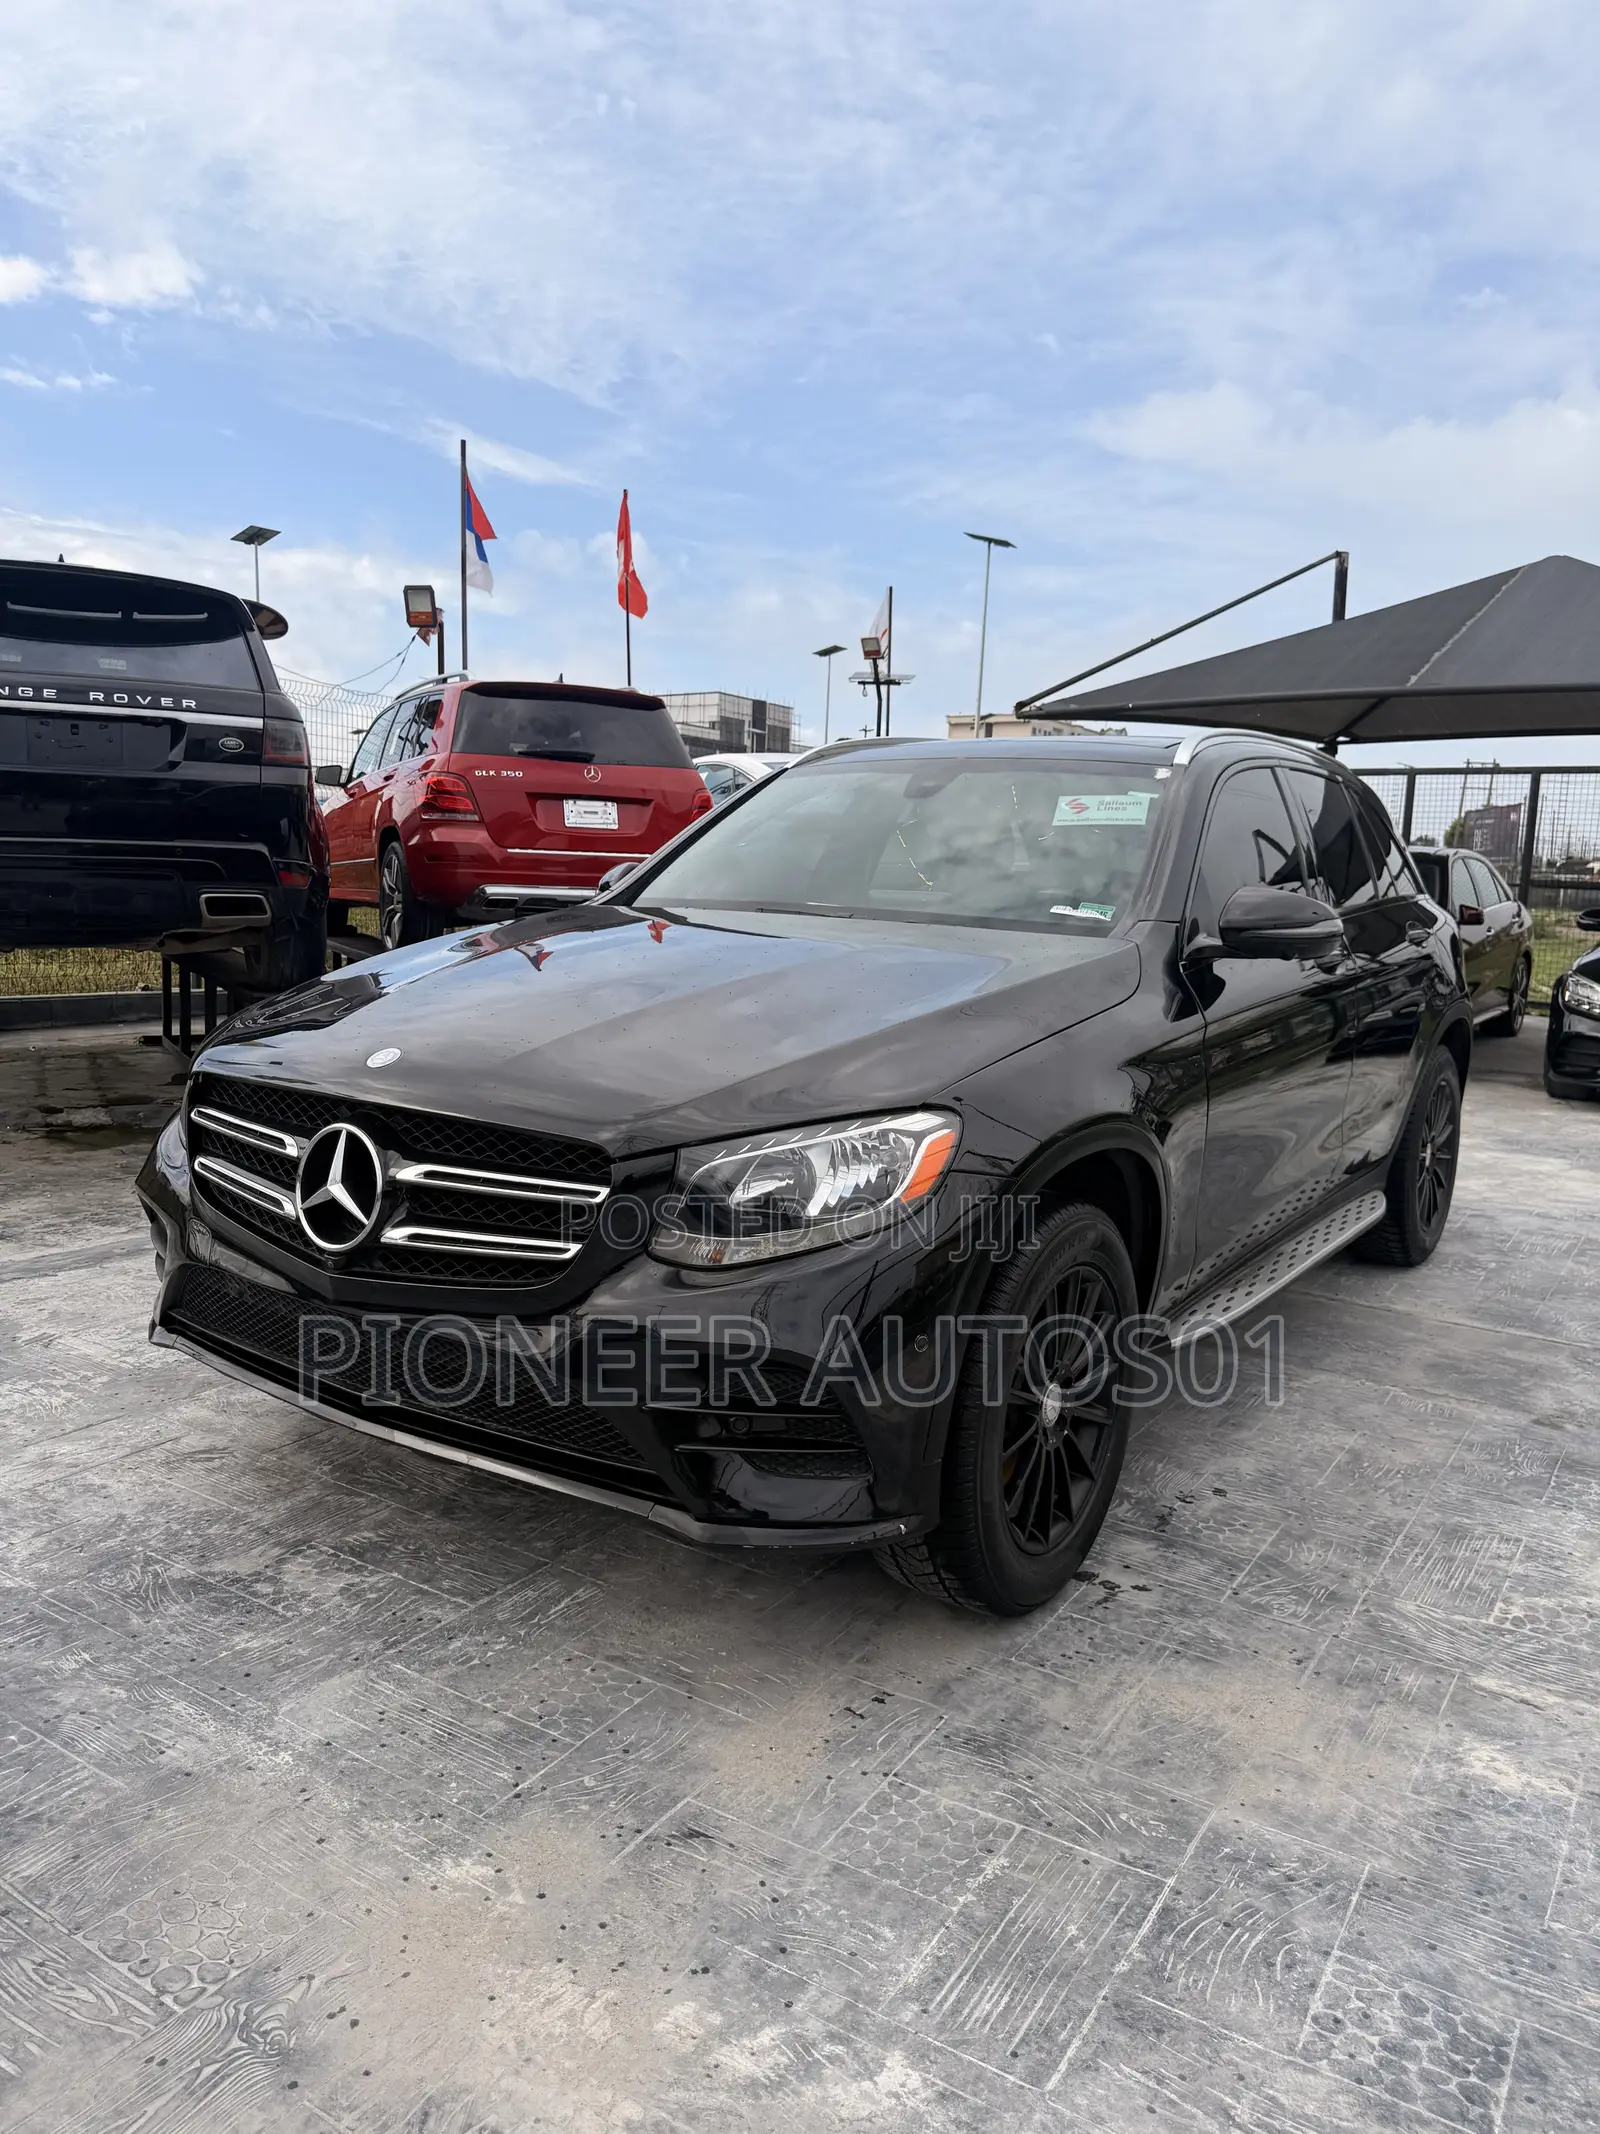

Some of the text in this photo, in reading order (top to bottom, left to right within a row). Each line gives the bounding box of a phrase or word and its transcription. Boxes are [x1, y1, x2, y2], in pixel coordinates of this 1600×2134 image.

[89, 691, 197, 709] ROVER
[475, 769, 524, 778] GLK 350
